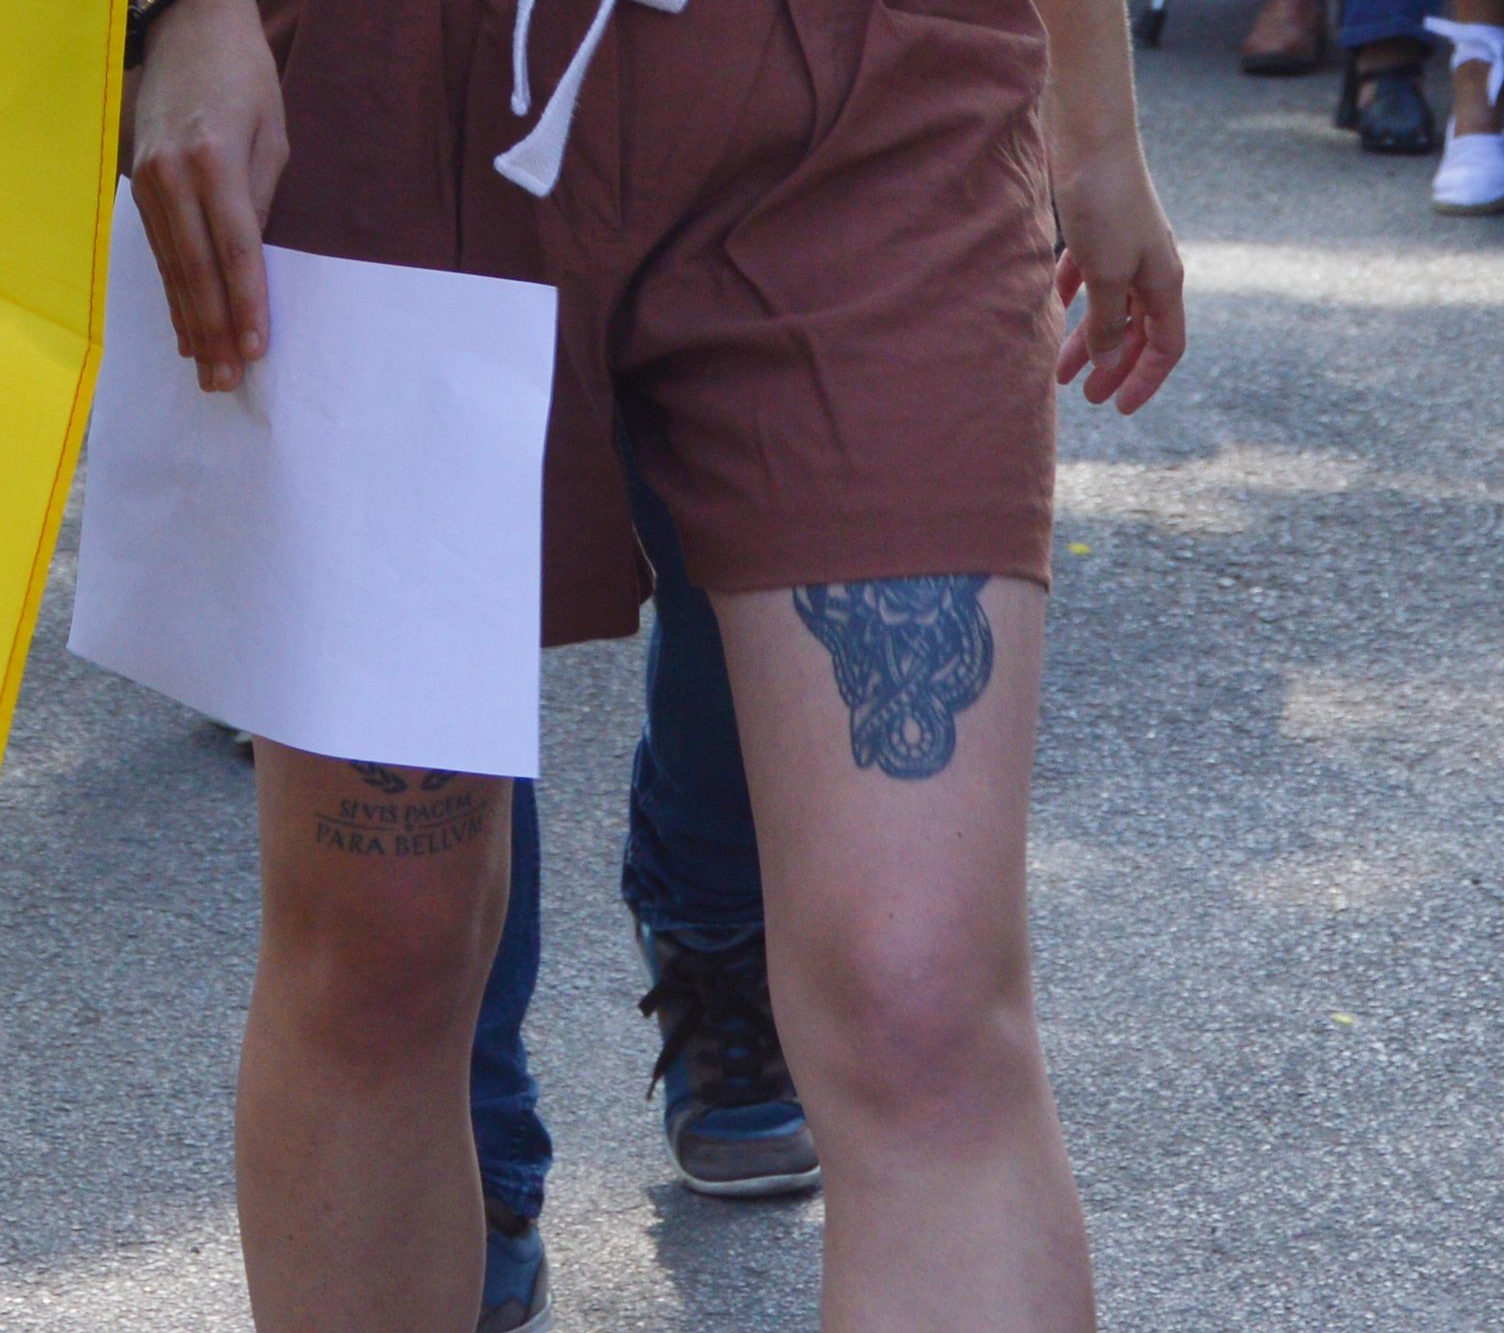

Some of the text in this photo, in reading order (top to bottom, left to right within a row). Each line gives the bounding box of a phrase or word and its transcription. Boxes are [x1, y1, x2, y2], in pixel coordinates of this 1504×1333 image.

[341, 793, 472, 823] SI VIS PACEM
[317, 823, 385, 856] PARA
